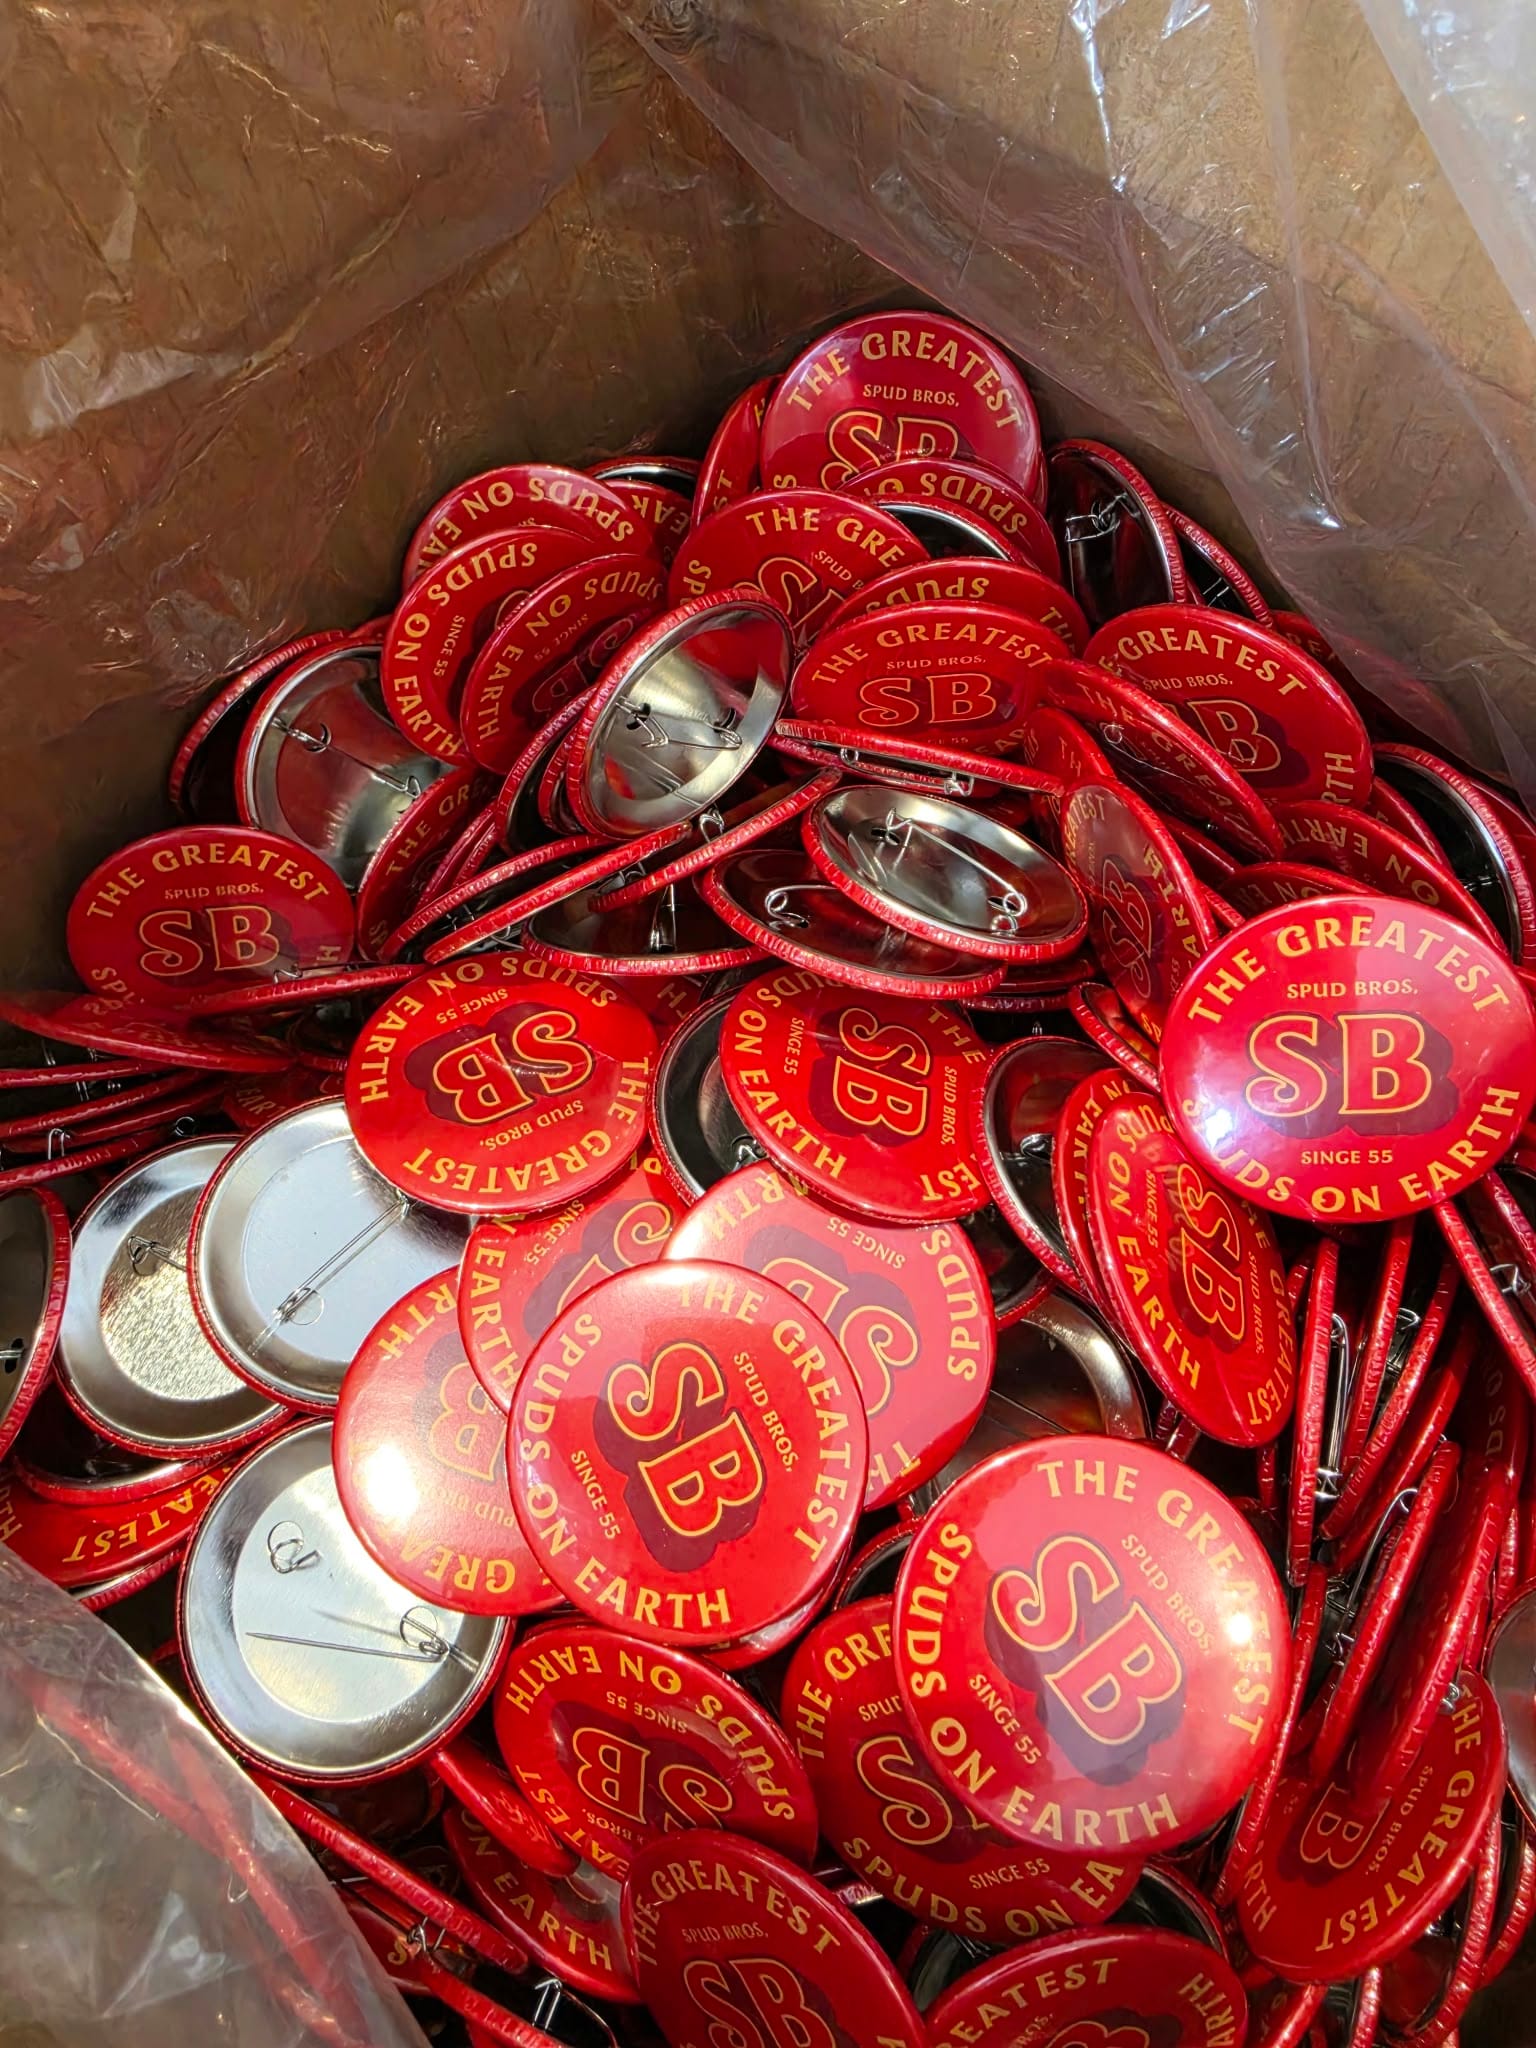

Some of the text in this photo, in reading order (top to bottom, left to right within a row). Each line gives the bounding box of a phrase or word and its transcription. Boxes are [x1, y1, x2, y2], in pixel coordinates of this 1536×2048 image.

[787, 329, 1022, 431] THE GREATEST
[863, 384, 960, 407] SPUD BROS.
[462, 476, 634, 542] SPUDS ON
[745, 507, 821, 537] THE
[920, 473, 1027, 533] SPUDS
[427, 542, 538, 607] SPUDS
[814, 549, 850, 581] SPUD
[395, 612, 430, 662] ON
[525, 594, 572, 637] ON
[812, 643, 869, 686] THE
[876, 622, 1052, 670] GREATEST
[886, 659, 934, 670] SPUD
[1118, 627, 1307, 696] GREATEST
[393, 676, 462, 756] EARTH
[478, 644, 524, 740] EARTH
[859, 673, 996, 727] SB
[86, 842, 331, 919] THE GREATEST
[164, 887, 210, 900] SPUD
[1385, 854, 1440, 905] ON
[139, 904, 280, 977] SB
[1188, 948, 1266, 1025] THE
[1276, 915, 1509, 1012] GREATEST
[427, 962, 485, 997] ON
[436, 988, 509, 1024] SINCE 55
[502, 956, 618, 1008] SPUDS
[1287, 979, 1419, 999] SPUD BROS.
[360, 994, 425, 1104] EARTH
[432, 1009, 593, 1124] SB
[735, 1009, 767, 1056] ON
[784, 1017, 805, 1075] SINCE 55
[928, 1006, 986, 1065] THE
[1245, 1013, 1432, 1118] SB
[608, 1057, 650, 1125] THE
[832, 1008, 930, 1137] SB
[943, 1066, 957, 1109] SPUD
[536, 1099, 584, 1128] SPUD
[740, 1068, 848, 1180] EARTH
[402, 1129, 612, 1193] GREATEST
[1108, 1152, 1131, 1217] ON
[1181, 1086, 1521, 1214] SUDS ON EARTH
[1301, 1149, 1393, 1164] SINCE 55
[826, 1217, 907, 1270] SINCE 55
[1176, 1161, 1246, 1342] SB
[470, 1245, 526, 1390] EARTH
[921, 1229, 981, 1382] SPUDS
[1118, 1236, 1202, 1390] EARTH
[1248, 1269, 1294, 1425] GREATEST
[607, 1341, 764, 1538] SB
[679, 1279, 851, 1562] THE GREATEST
[733, 1351, 800, 1472] SPUD BROS.
[522, 1312, 732, 1629] SPUDS ON EARTH
[570, 1450, 621, 1540] SINCE 55
[1120, 1533, 1171, 1591] SPUD
[907, 1522, 974, 1698] SPUDS
[1037, 1460, 1272, 1746] THE GREATEST
[991, 1535, 1183, 1745] SB
[506, 1645, 796, 1821] SPUDS ON EARTH
[605, 1691, 689, 1734] SINCE 55
[795, 1679, 833, 1760] THE
[967, 1672, 1042, 1766] SINCE 55
[930, 1716, 997, 1795] ON
[1001, 1785, 1180, 1847] EARTH
[1315, 1683, 1482, 1953] THE GREATEST
[1400, 1765, 1434, 1818] SPUD
[842, 1836, 987, 1934] SPUDS
[1004, 1899, 1074, 1937] ON
[968, 1858, 1051, 1890] SINCE 55
[493, 1871, 614, 1973] EARTH
[633, 1859, 840, 1966] THE GREATEST
[681, 1925, 721, 1944] SPUD
